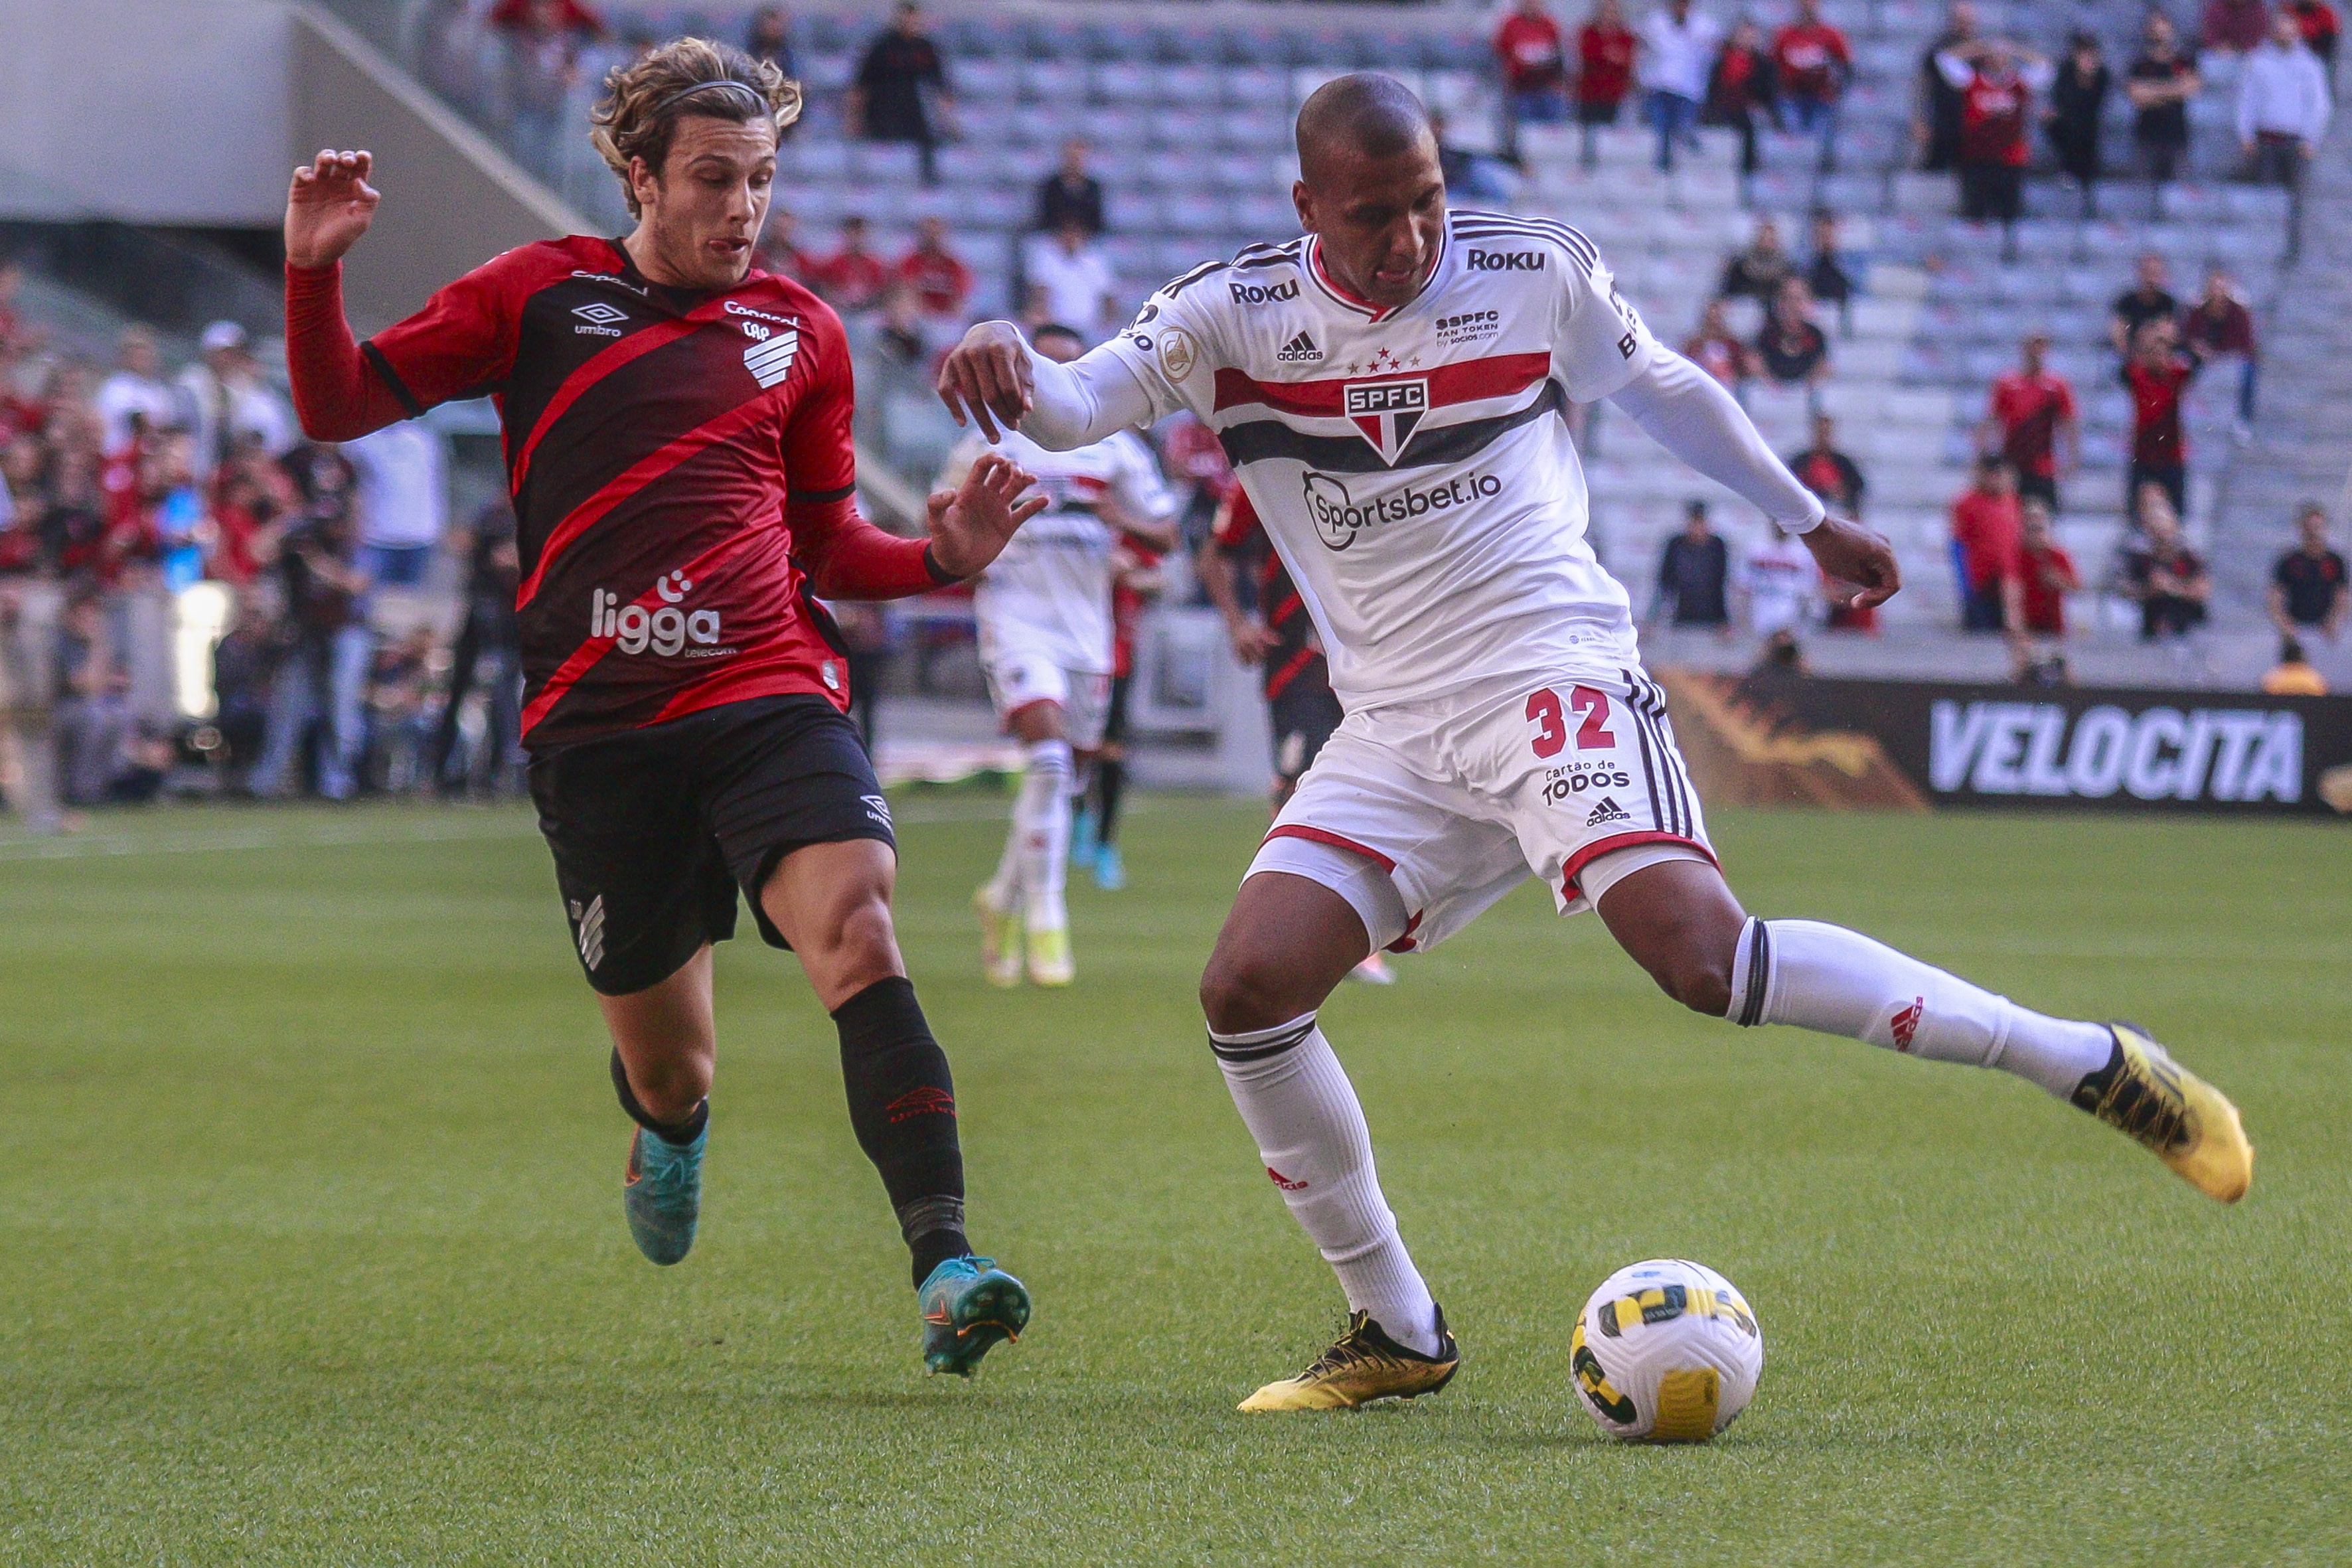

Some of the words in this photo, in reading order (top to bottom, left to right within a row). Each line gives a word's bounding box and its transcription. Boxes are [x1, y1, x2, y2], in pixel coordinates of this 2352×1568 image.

[575, 325, 622, 337] umbro
[742, 321, 770, 341] CAP
[1437, 329, 1458, 338] FAN
[1462, 324, 1498, 333] TOKEN
[1277, 350, 1323, 361] adidas
[1350, 387, 1422, 409] SPFC
[1316, 471, 1502, 533] Sportsbet.io
[591, 588, 720, 657] ligga
[684, 647, 737, 659] telecom
[1526, 684, 1616, 759] 32
[1928, 698, 2305, 803] VELOCITA
[1545, 761, 1592, 781] Cartão
[1597, 760, 1615, 769] de
[1541, 772, 1630, 807] TODOS
[866, 811, 894, 836] umb
[1586, 811, 1630, 827] adidas
